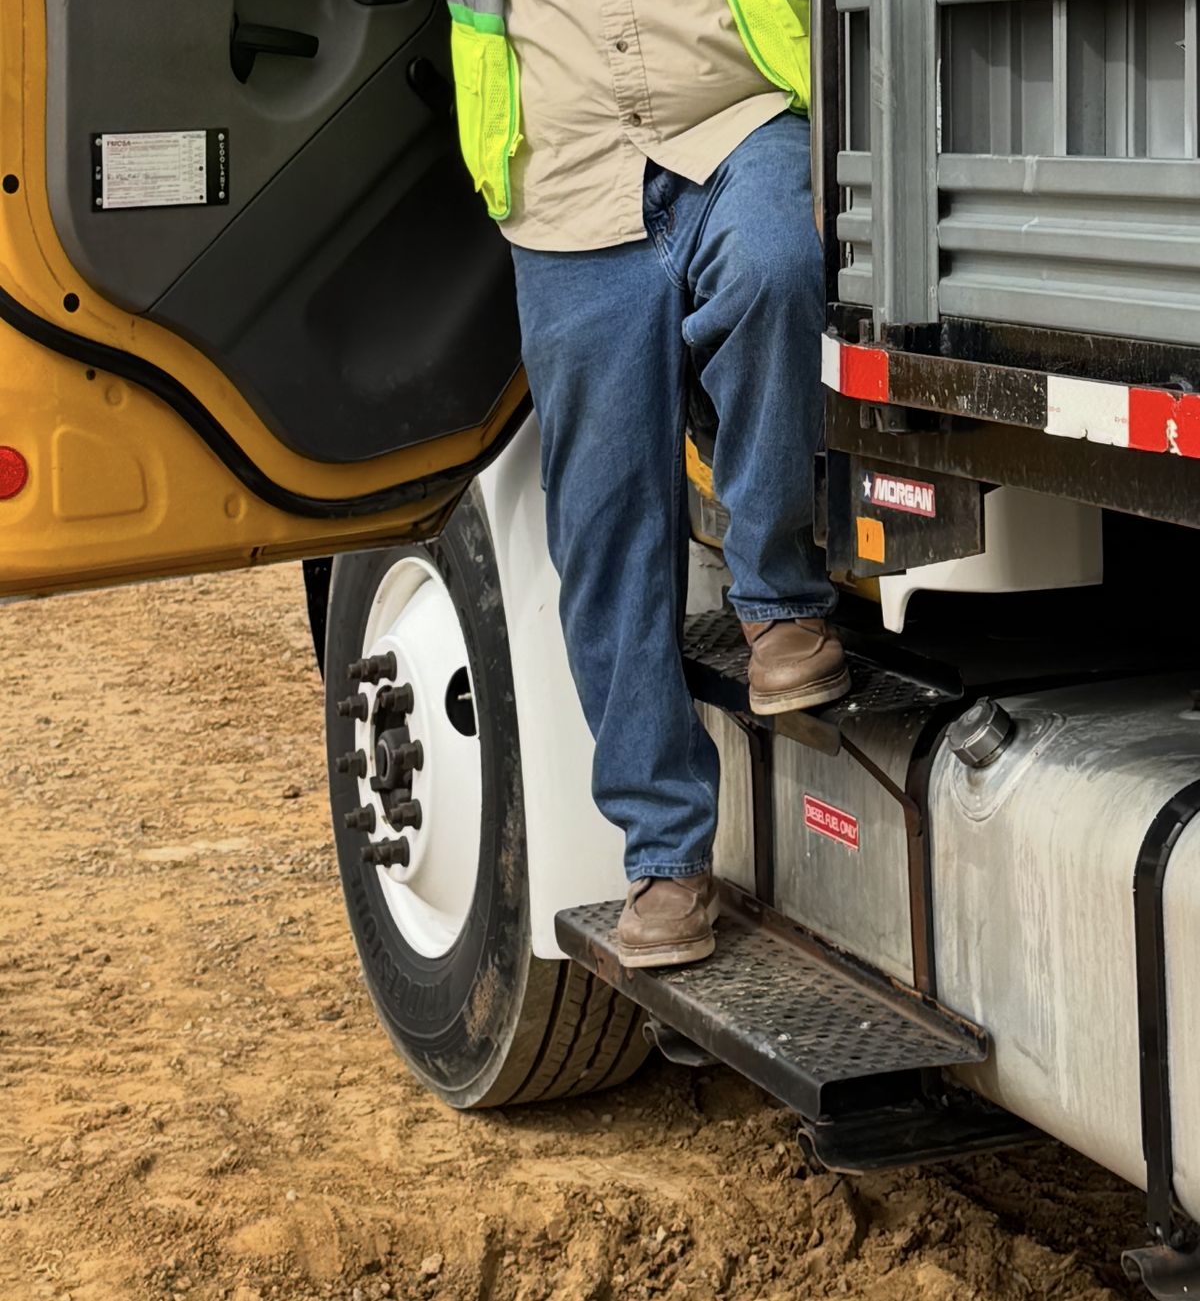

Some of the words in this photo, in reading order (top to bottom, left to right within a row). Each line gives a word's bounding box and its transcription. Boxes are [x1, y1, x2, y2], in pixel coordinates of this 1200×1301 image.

[873, 477, 934, 512] MORGAN
[805, 803, 825, 825] DIESEL
[825, 813, 840, 832] FUEL
[840, 820, 857, 839] ONLY
